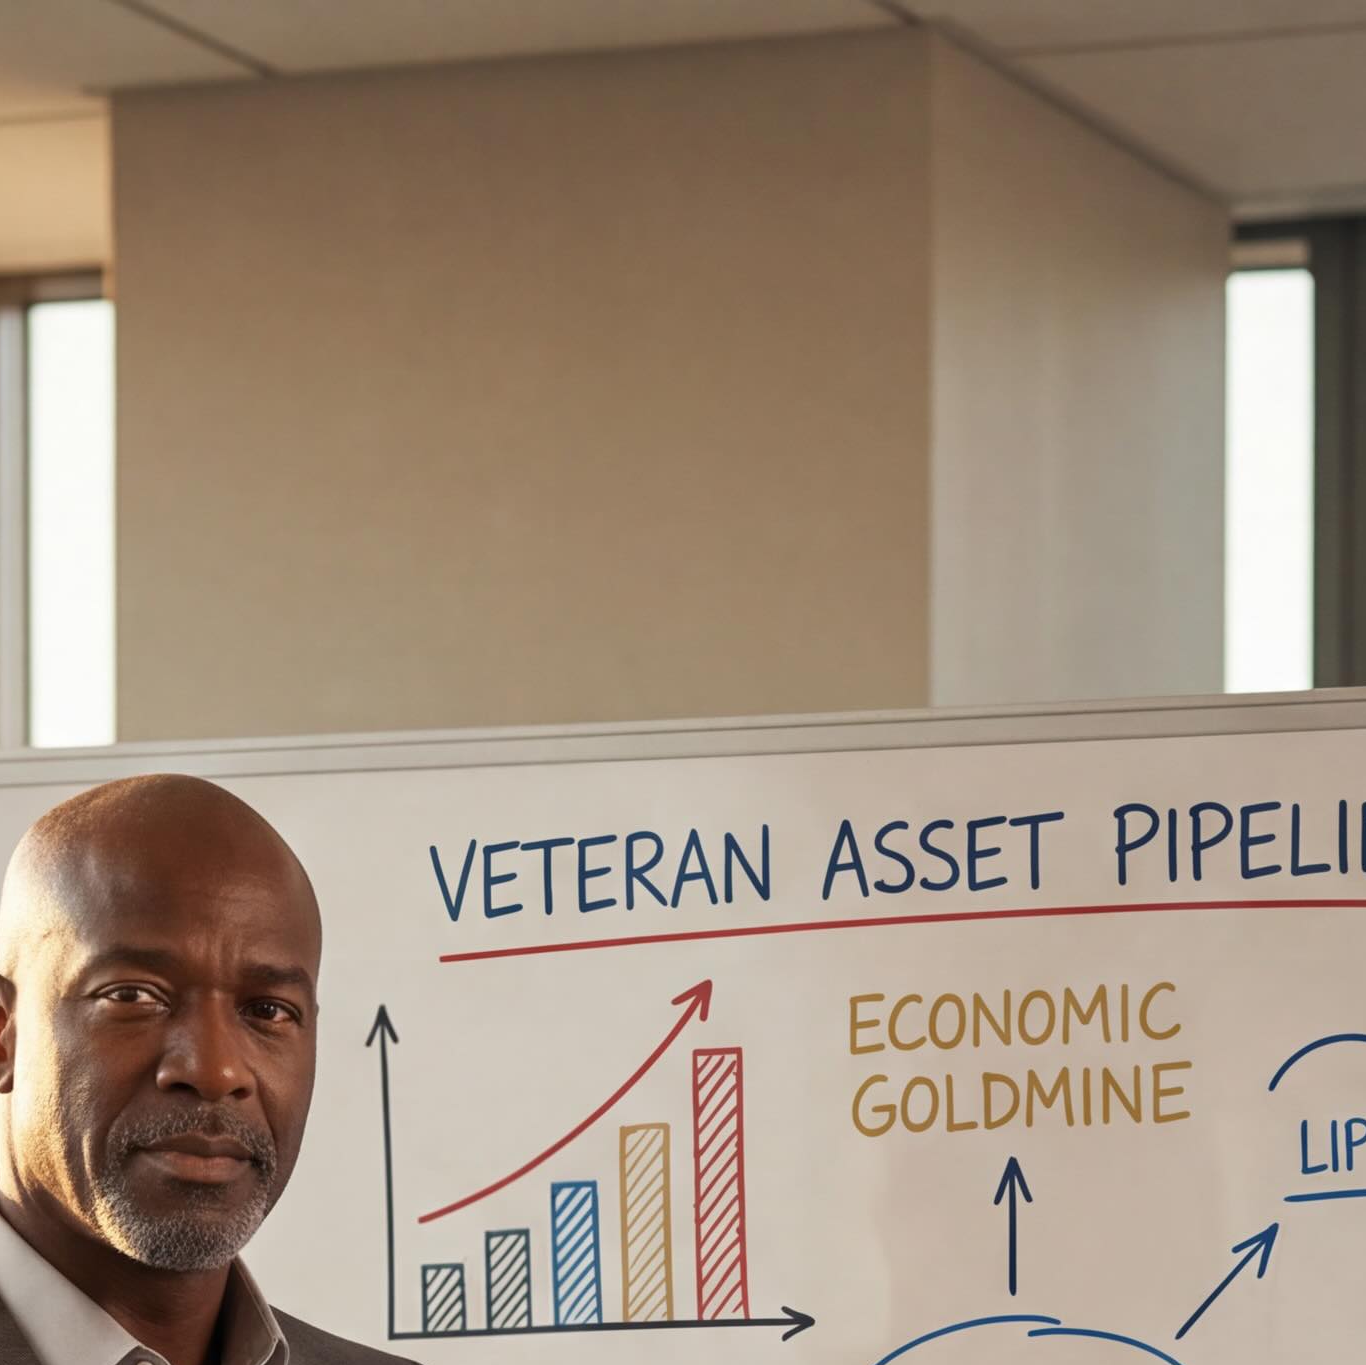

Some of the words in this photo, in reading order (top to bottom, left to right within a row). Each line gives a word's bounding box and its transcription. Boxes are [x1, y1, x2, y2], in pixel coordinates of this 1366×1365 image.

[430, 823, 770, 921] VETERAN
[823, 811, 1065, 900] ASSET
[849, 981, 1182, 1055] ECONOMIC
[851, 1060, 1193, 1138] GOLDMINE
